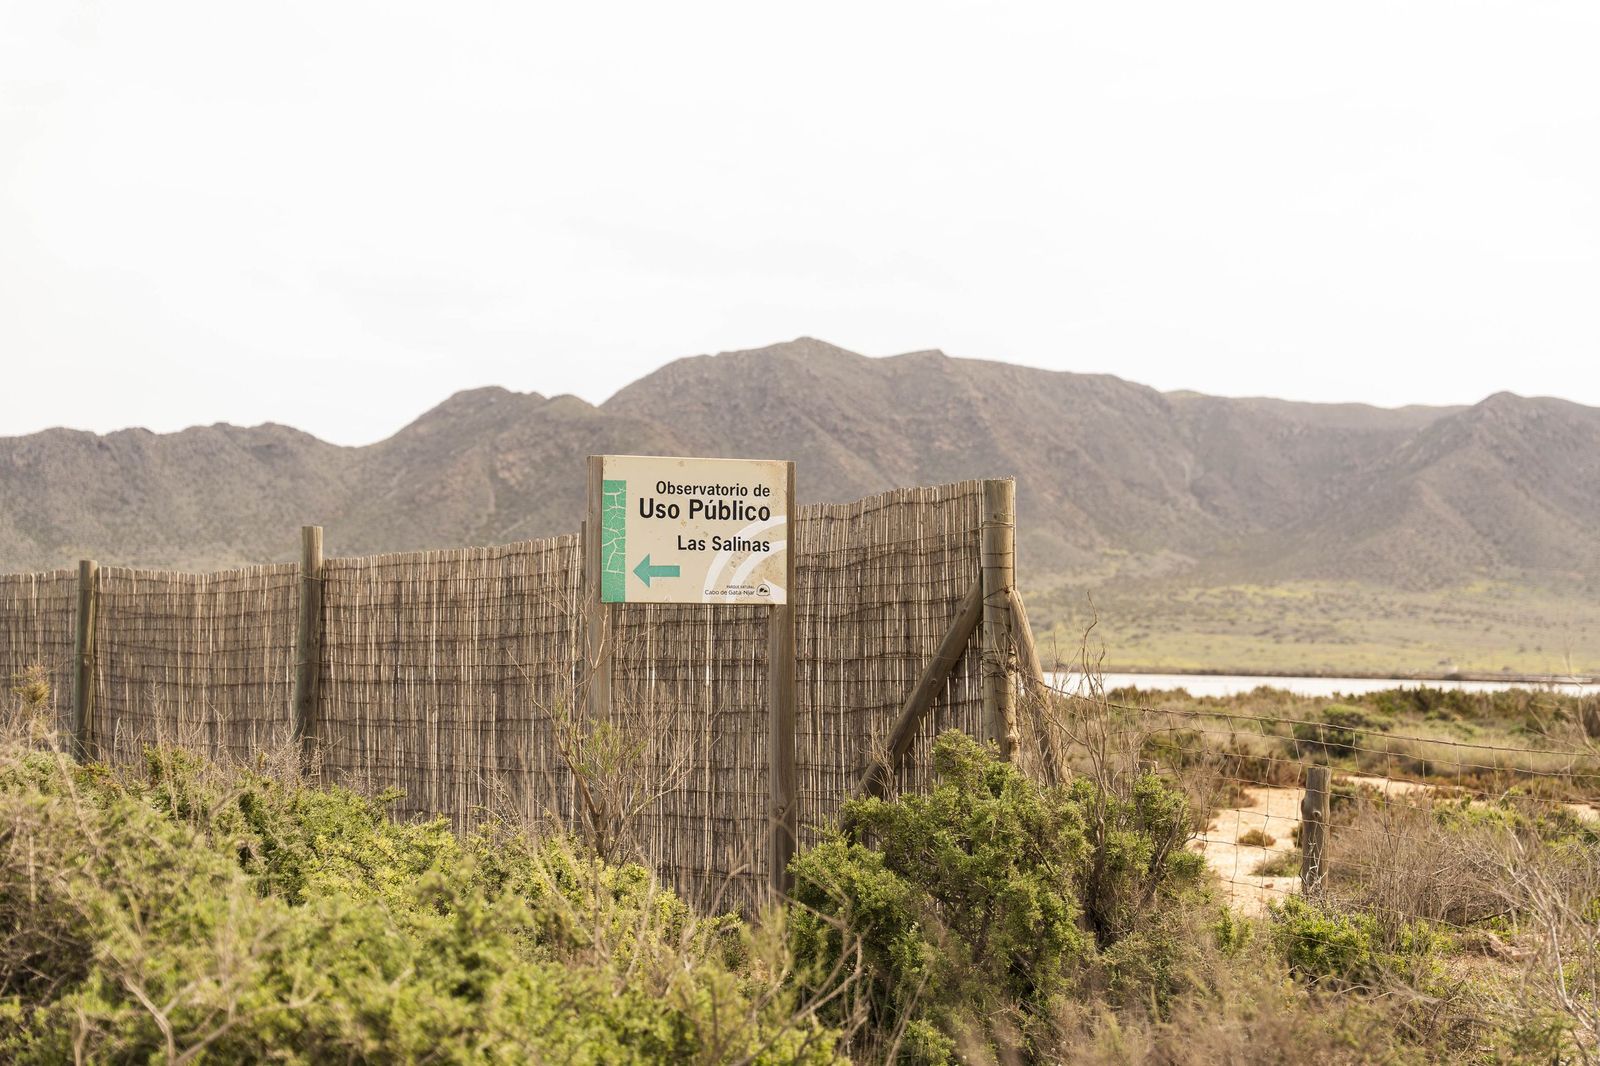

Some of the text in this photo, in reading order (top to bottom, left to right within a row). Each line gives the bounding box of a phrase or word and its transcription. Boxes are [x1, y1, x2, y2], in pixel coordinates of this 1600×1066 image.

[656, 480, 770, 497] Observatorio de
[639, 497, 771, 521] Uso Público
[677, 535, 770, 552] Las Salinas
